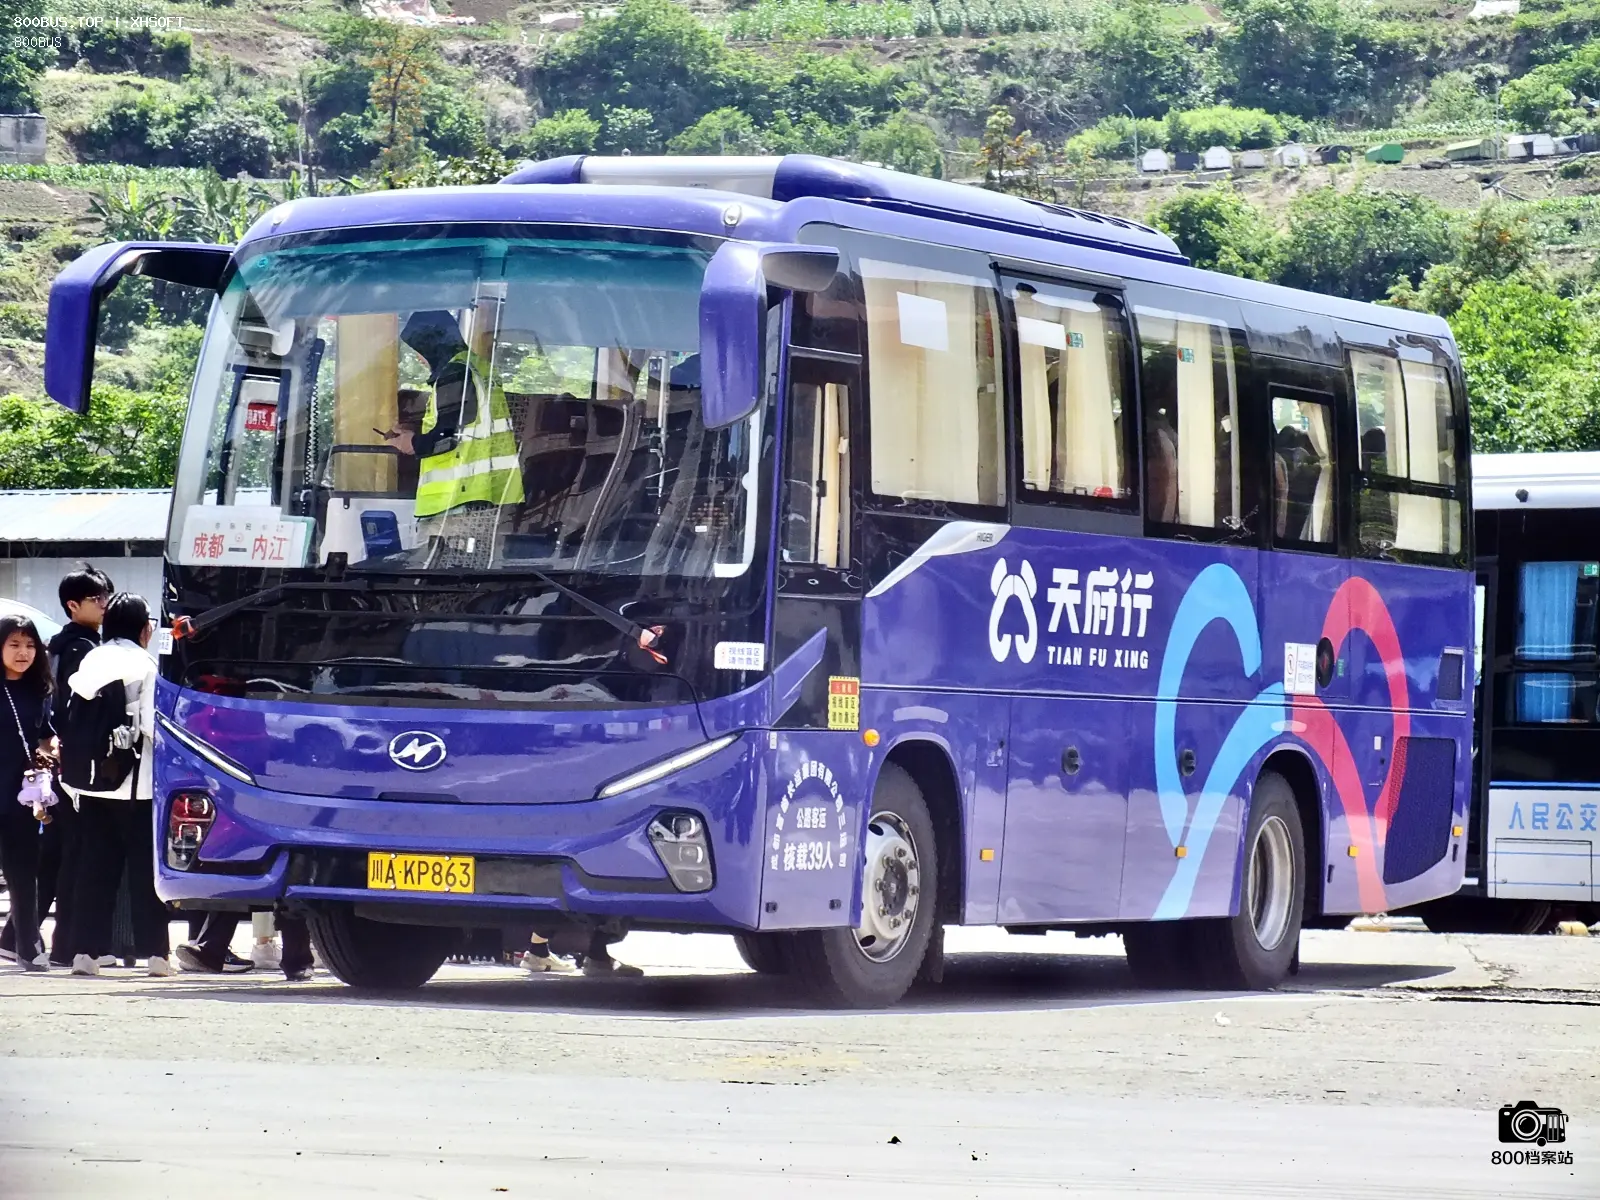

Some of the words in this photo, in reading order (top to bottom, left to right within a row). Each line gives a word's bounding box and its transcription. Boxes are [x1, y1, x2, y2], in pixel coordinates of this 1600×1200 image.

[1046, 565, 1155, 638] 天府行
[1047, 646, 1083, 666] TIAN
[1089, 648, 1108, 667] FU
[1114, 649, 1149, 670] XING
[796, 807, 827, 829] 公路客运
[1508, 801, 1599, 831] 人民公交
[783, 840, 834, 871] 核载39人
[371, 859, 471, 887] 川A·KP863
